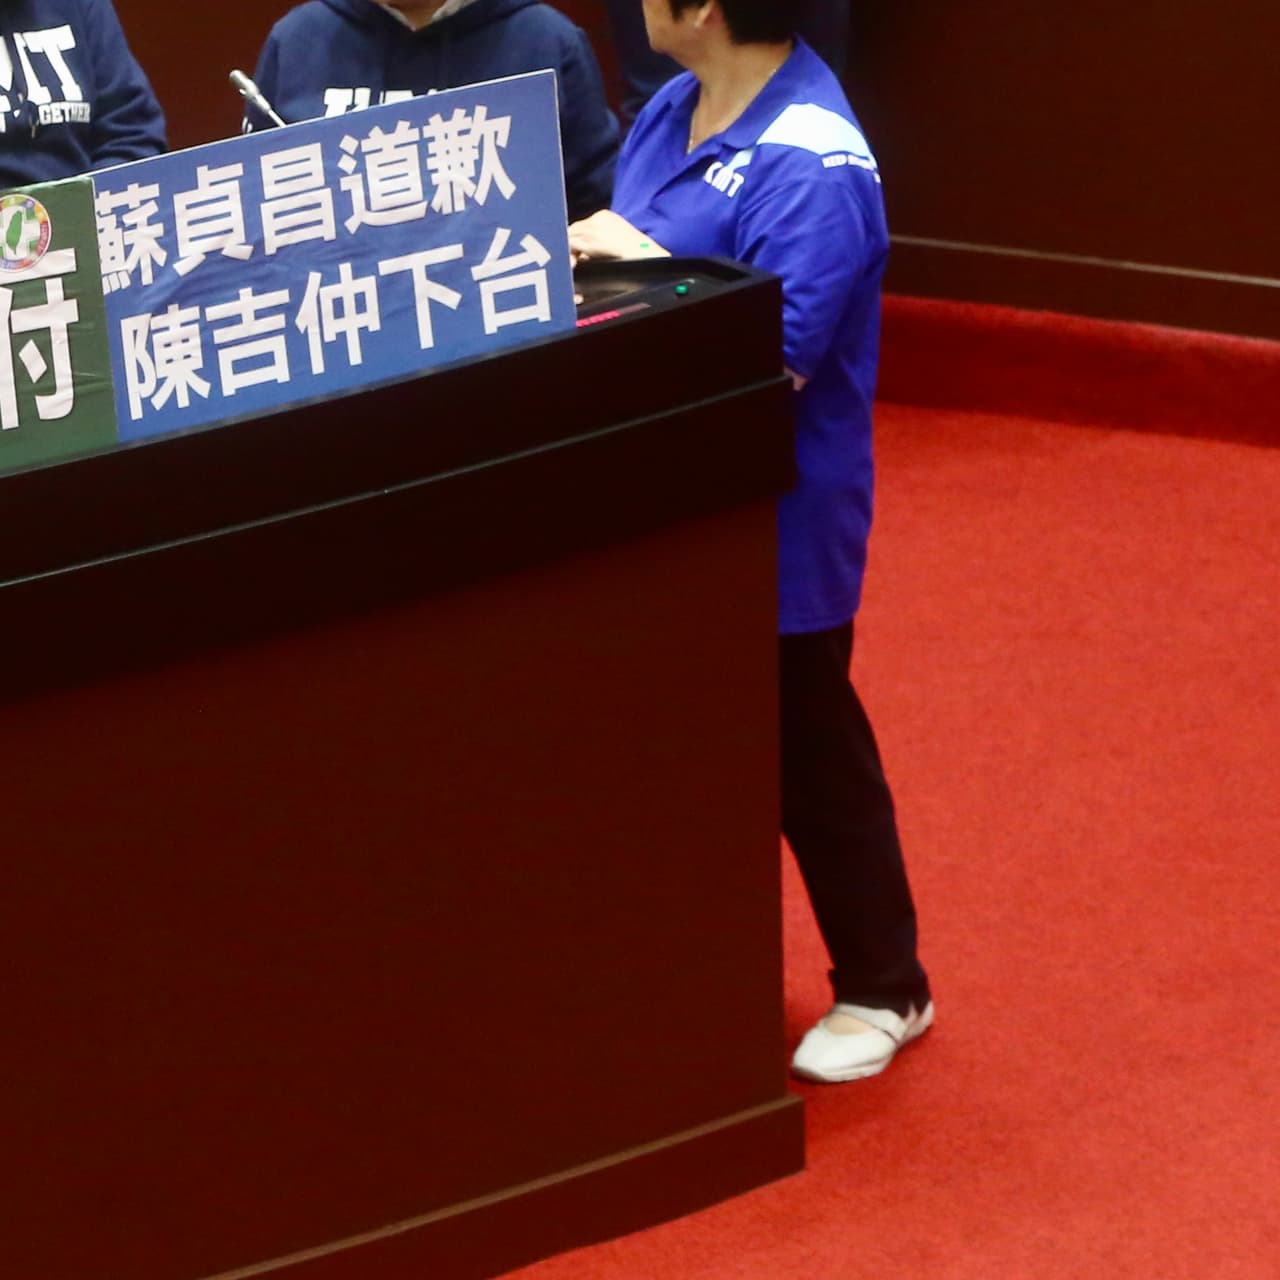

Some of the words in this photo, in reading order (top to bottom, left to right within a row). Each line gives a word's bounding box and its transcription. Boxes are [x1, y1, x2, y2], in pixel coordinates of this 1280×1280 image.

[94, 105, 517, 296] 蘇貞昌道歉
[121, 227, 552, 421] 陳吉仲下台
